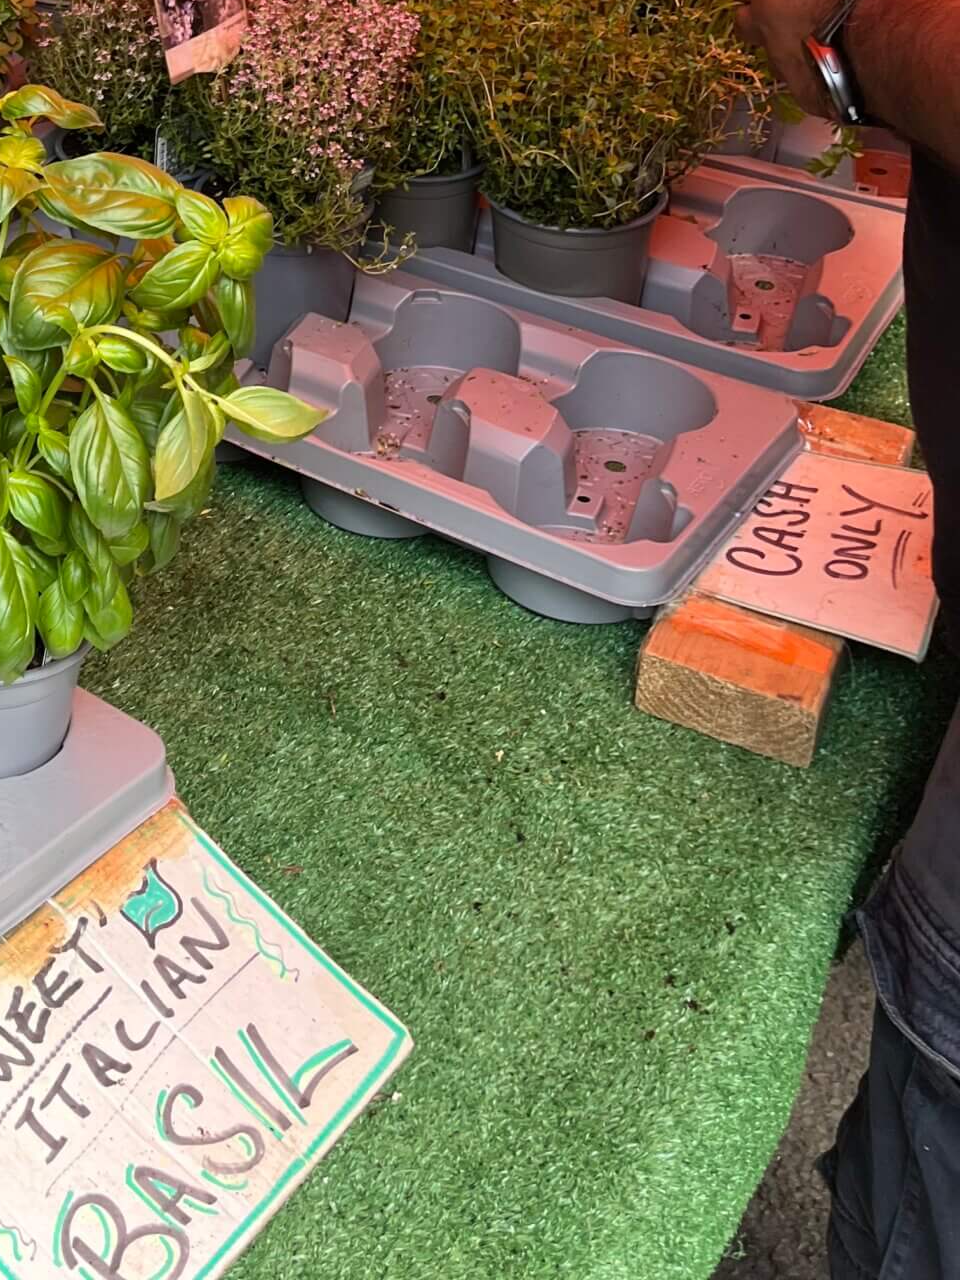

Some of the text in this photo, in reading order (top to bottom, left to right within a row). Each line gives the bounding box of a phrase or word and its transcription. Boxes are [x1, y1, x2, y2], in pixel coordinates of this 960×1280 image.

[725, 479, 819, 576] CASH
[823, 484, 929, 580] ONLY
[14, 896, 230, 1164] ITALIAN
[53, 1022, 359, 1280] BASIL
